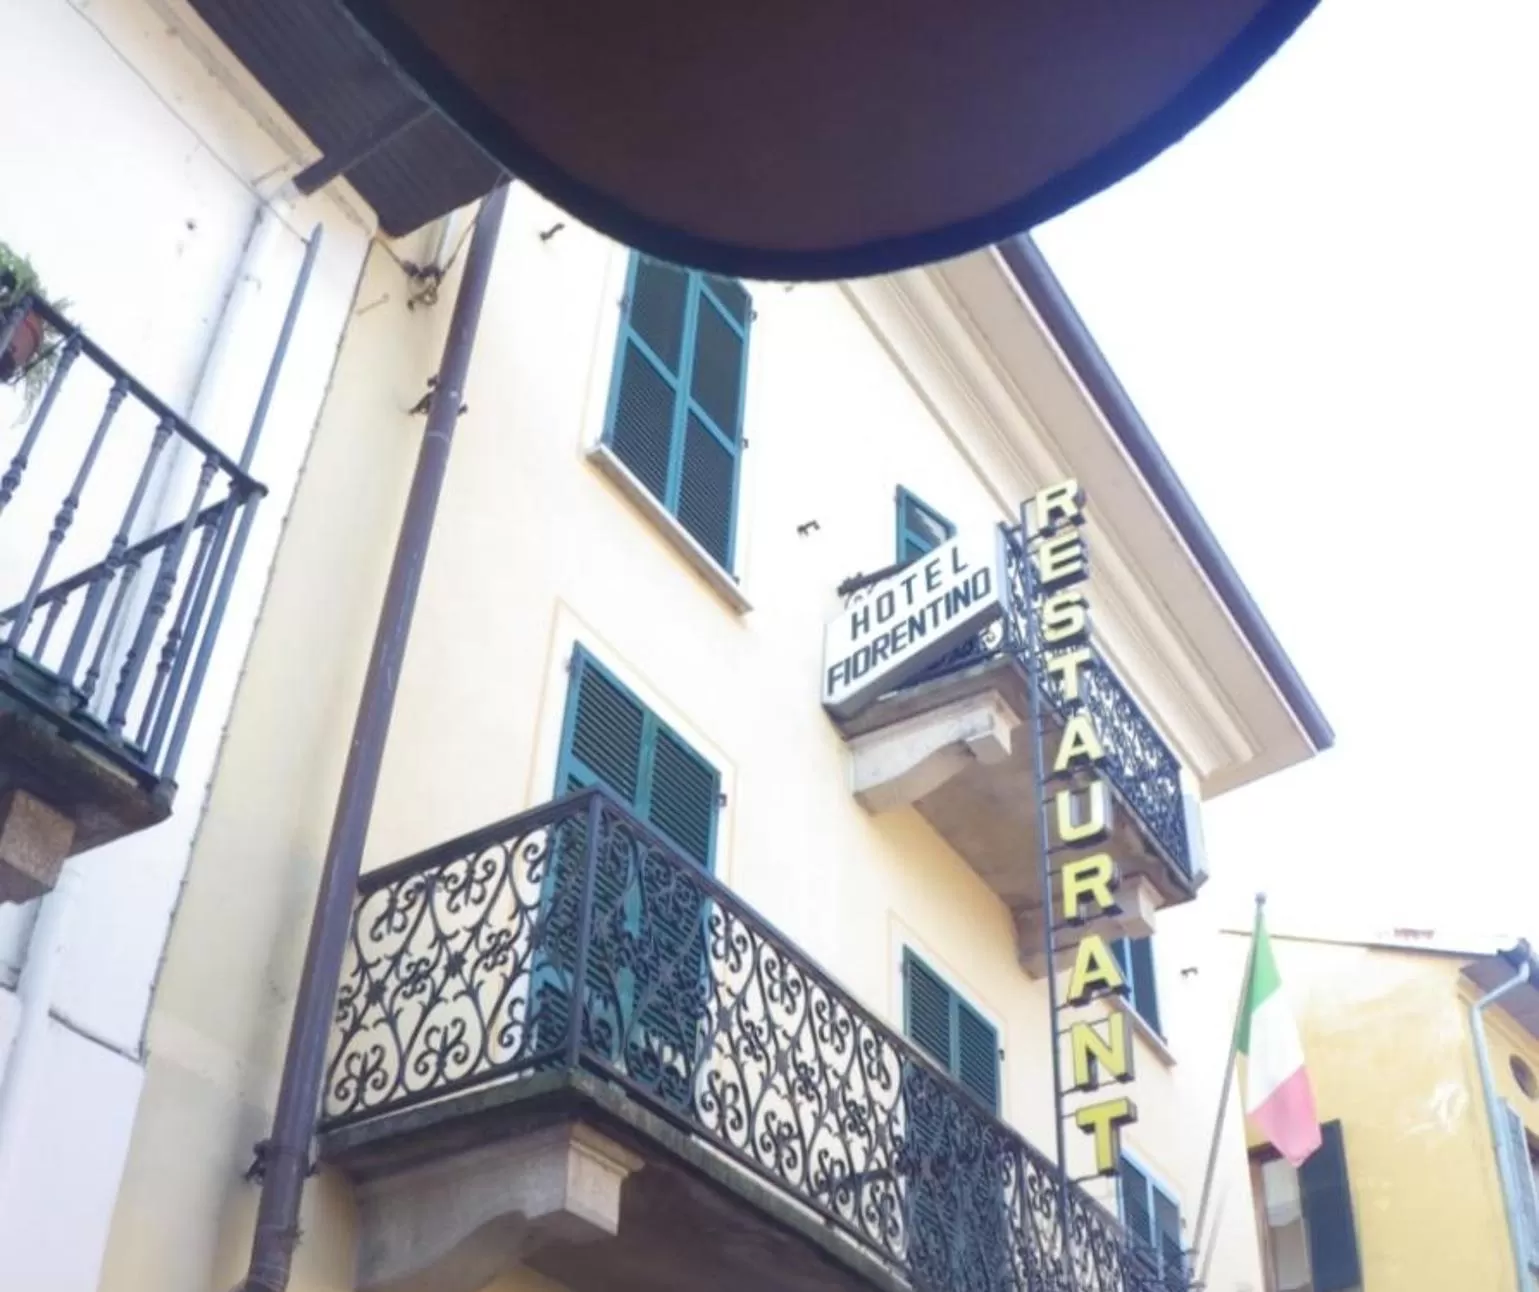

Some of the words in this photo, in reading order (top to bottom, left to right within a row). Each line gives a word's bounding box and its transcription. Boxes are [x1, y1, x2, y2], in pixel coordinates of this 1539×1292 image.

[827, 566, 991, 696] FIORENTINO
[851, 546, 969, 641] HOTEL
[1033, 477, 1136, 1177] RESTAURANT
